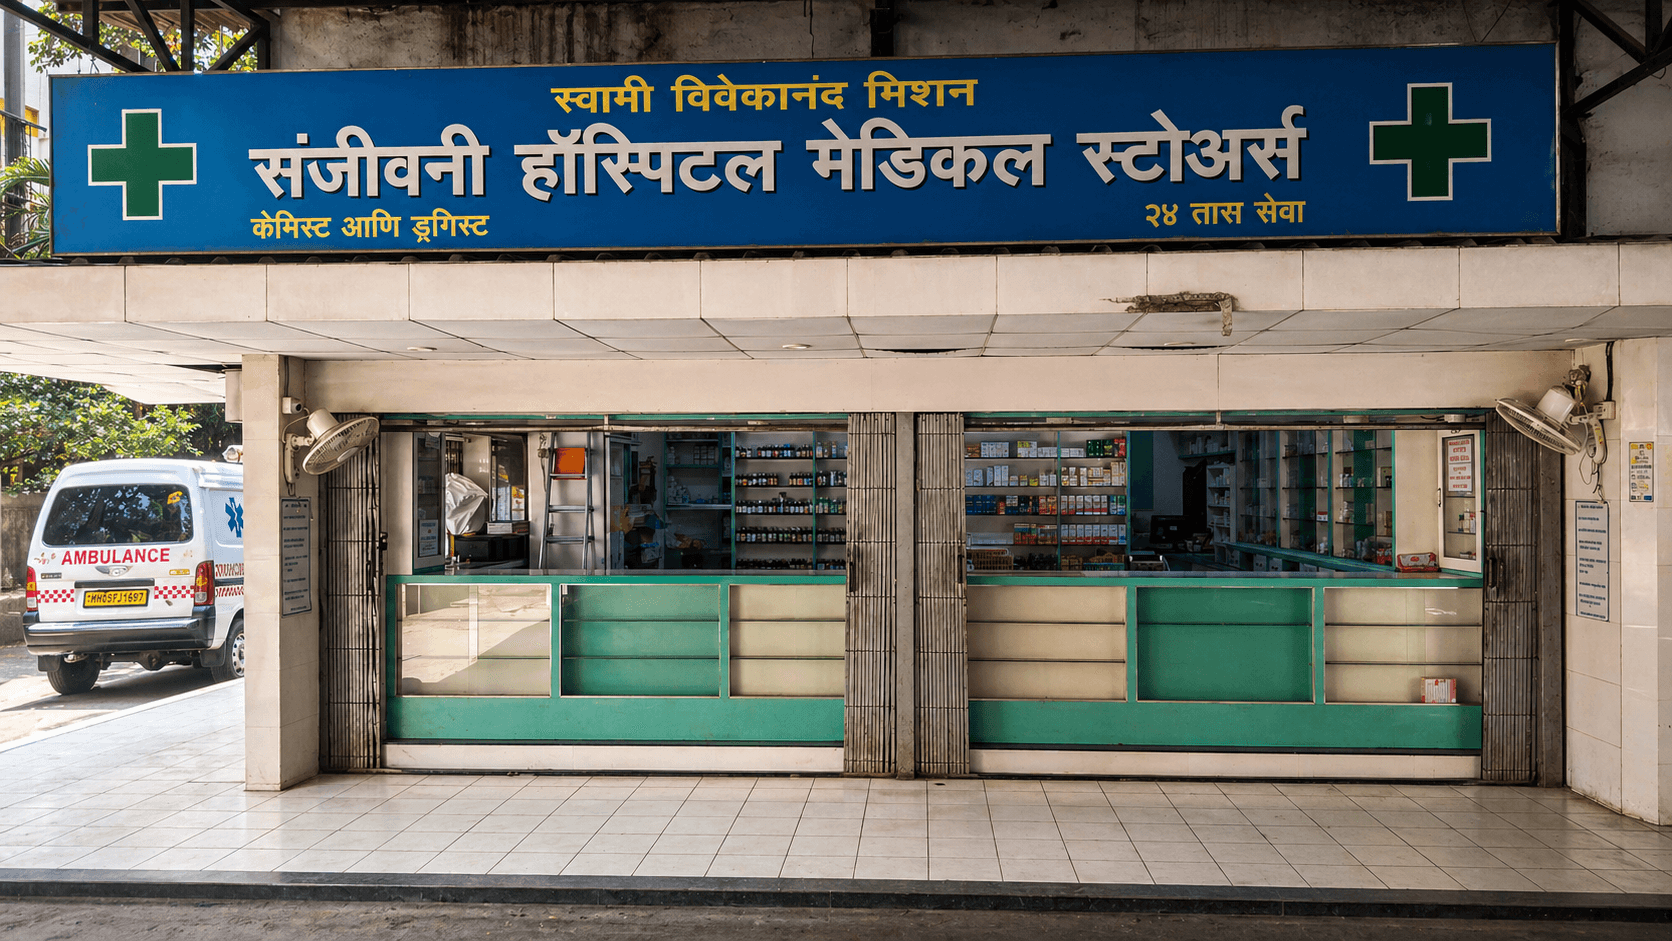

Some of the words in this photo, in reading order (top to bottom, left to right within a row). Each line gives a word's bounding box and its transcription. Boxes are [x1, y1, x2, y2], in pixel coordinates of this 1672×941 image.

[550, 75, 655, 114] स्वामी
[670, 74, 849, 113] विवेकानंद
[863, 71, 979, 109] मिशन
[248, 125, 490, 199] संजीवनी
[514, 122, 783, 202] हॉस्पिटल
[805, 117, 1052, 192] मेडिकल
[1076, 105, 1308, 183] स्टोअर्स
[250, 210, 332, 239] केमिस्ट
[341, 208, 402, 238] आणि
[410, 207, 490, 243] ड्रगिस्ट
[1145, 204, 1179, 229] २४
[1189, 202, 1245, 225] तास
[1254, 193, 1306, 224] सेवा
[61, 547, 171, 566] AMBULANCE
